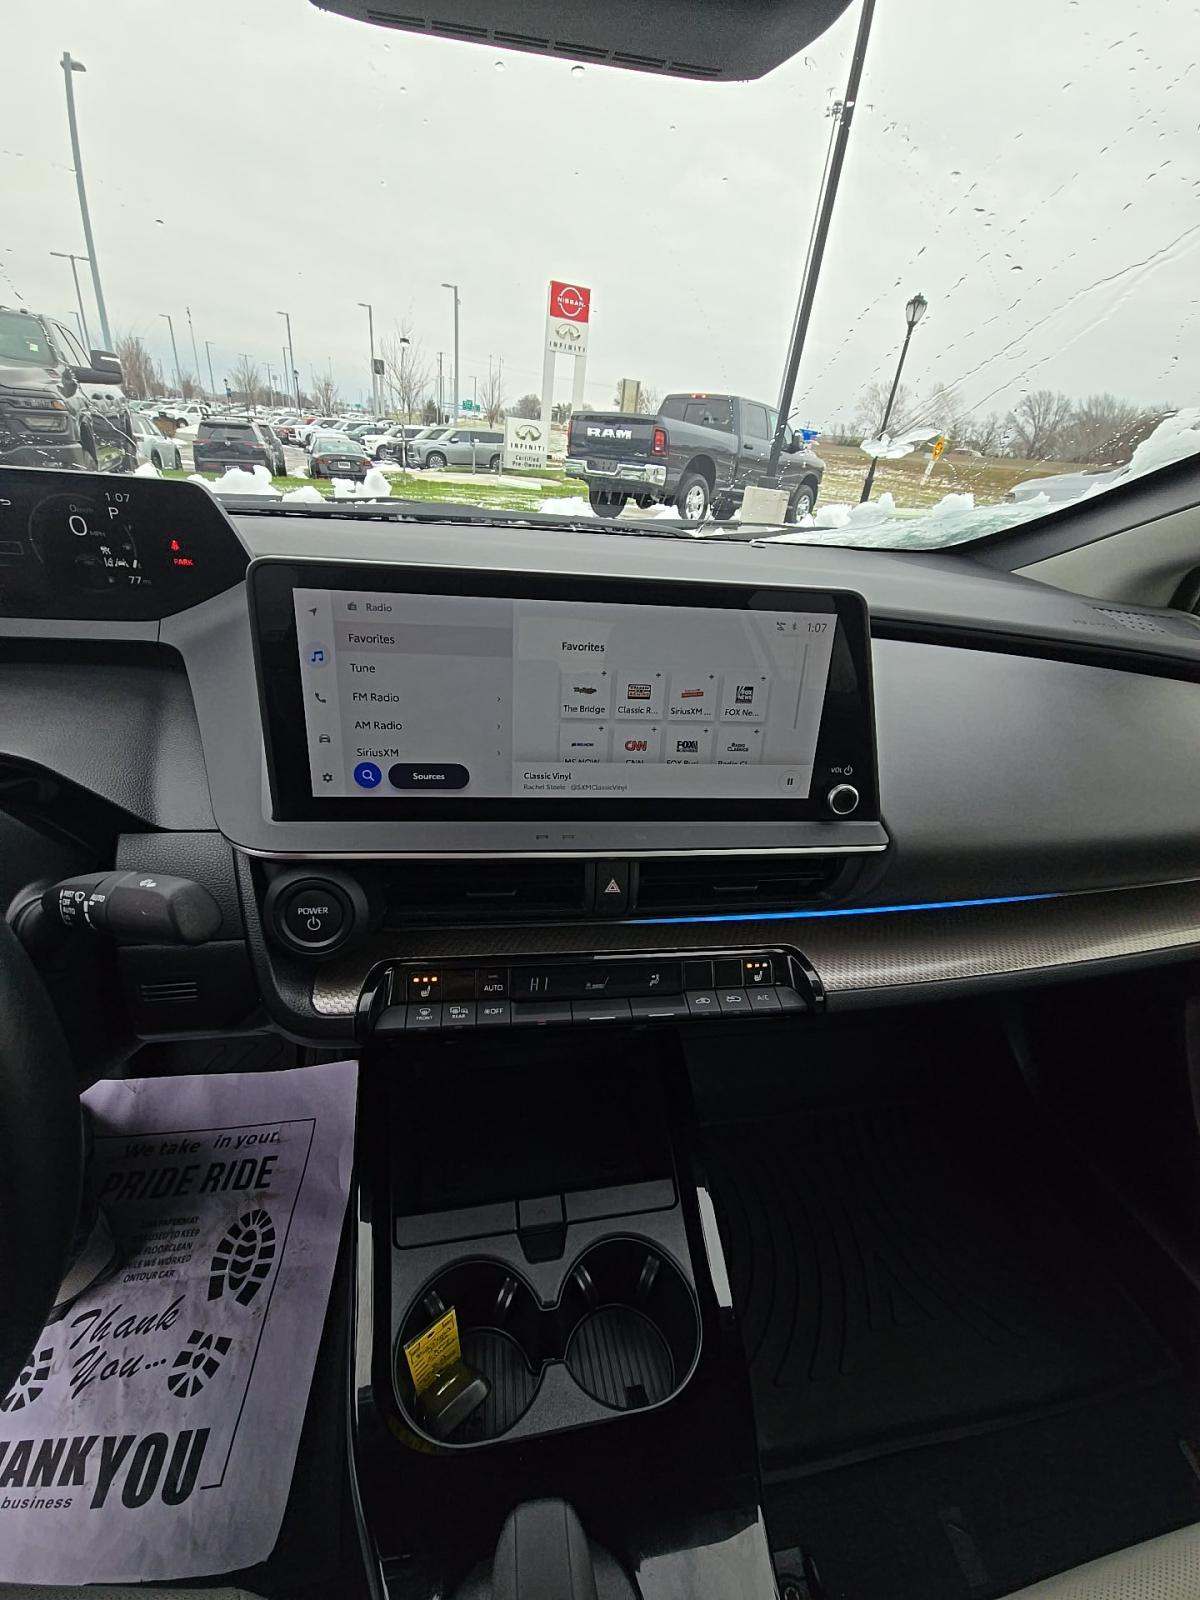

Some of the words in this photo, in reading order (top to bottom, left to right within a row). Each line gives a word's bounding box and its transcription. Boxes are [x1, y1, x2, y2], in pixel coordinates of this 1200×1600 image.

[557, 296, 584, 307] NISSAN
[549, 341, 586, 352] INFINITI
[586, 427, 632, 439] RAM
[510, 442, 545, 452] INFINITI
[108, 507, 118, 519] P
[68, 515, 88, 536] 0
[174, 558, 194, 566] PARK
[128, 575, 142, 585] 77
[366, 603, 392, 612] Radio
[807, 623, 827, 633] 1:07
[348, 634, 395, 644] Favorites
[561, 641, 605, 652] Favorites
[350, 664, 376, 673] Tune
[352, 692, 368, 702] FM
[370, 692, 400, 702] Radio
[563, 704, 578, 713] The
[579, 705, 605, 714] Bridge
[618, 706, 645, 714] Classic
[670, 707, 703, 715] SiriusXM
[724, 708, 741, 716] FOX
[354, 721, 371, 730] AM
[373, 721, 403, 730] Radio
[624, 740, 648, 751] CNN
[676, 740, 695, 750] FOX
[356, 748, 400, 757] SiriusXM
[412, 772, 445, 780] Sources
[523, 772, 551, 780] Classic
[552, 772, 572, 781] Vinyl
[297, 907, 329, 915] POWER
[483, 984, 504, 992] AUTO
[125, 1143, 155, 1158] We
[158, 1138, 201, 1155] take
[214, 1133, 231, 1149] in
[97, 1164, 200, 1202] PRIDE
[199, 1155, 279, 1194] RIDE
[69, 1294, 187, 1350] Thank
[89, 1427, 211, 1509] YOU
[0, 1497, 73, 1510] business
